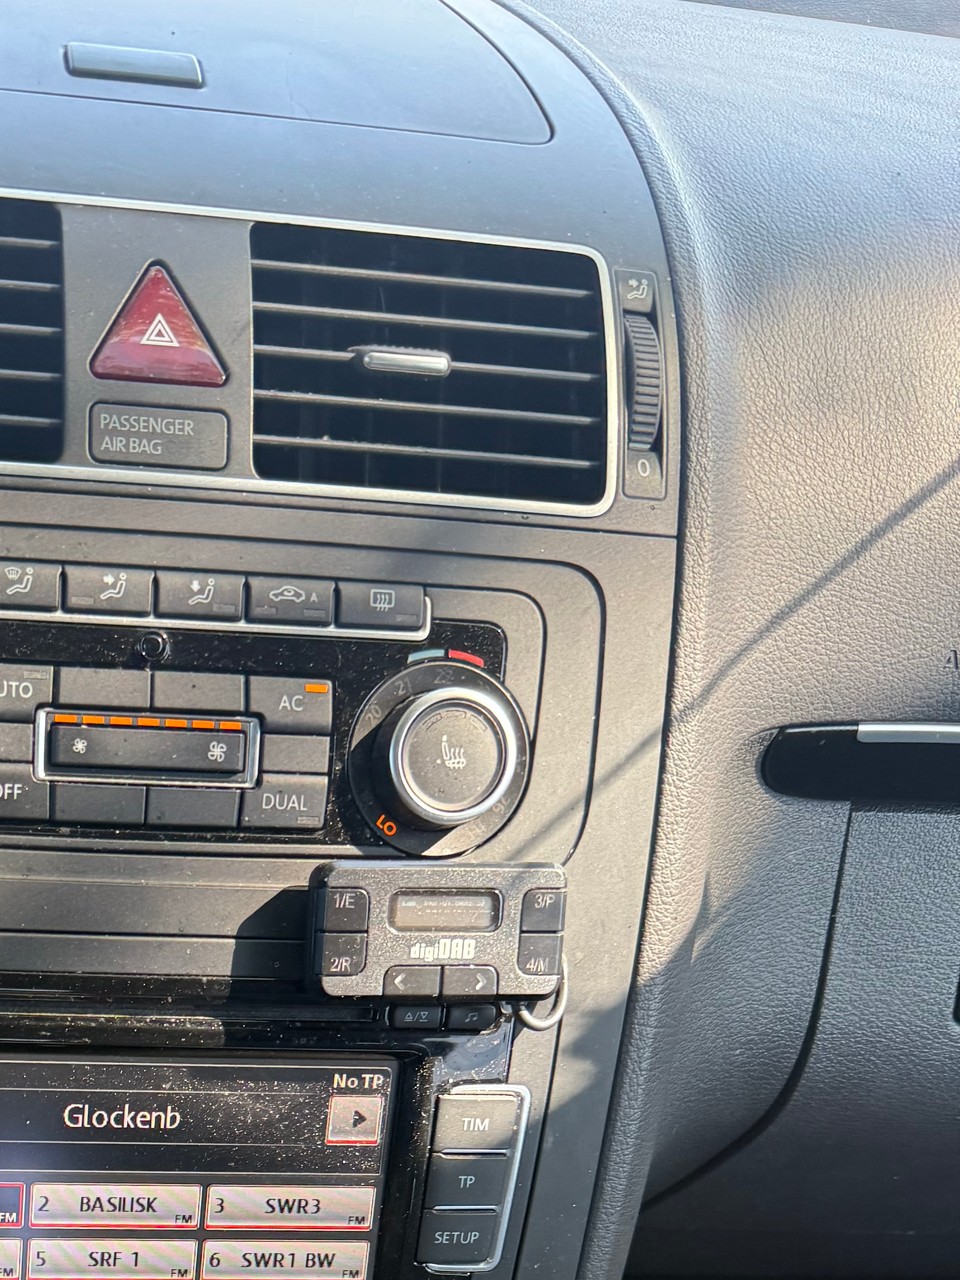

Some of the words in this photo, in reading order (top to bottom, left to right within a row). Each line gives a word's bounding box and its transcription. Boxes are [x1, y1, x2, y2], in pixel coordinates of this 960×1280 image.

[100, 413, 194, 436] PASSENGER
[100, 436, 126, 453] AIR
[129, 438, 162, 455] BAG
[637, 459, 650, 477] 0
[310, 593, 318, 603] A
[279, 695, 304, 712] AC
[261, 792, 308, 812] DUAL
[375, 814, 397, 836] LO
[334, 893, 355, 909] 1/E
[534, 894, 555, 909] 3/P
[410, 938, 476, 962] digiDAB
[330, 957, 350, 972] 2/R
[333, 1073, 358, 1088] No
[362, 1074, 383, 1088] TP
[63, 1103, 181, 1130] Glockenb
[461, 1117, 490, 1131] TIM
[458, 1175, 475, 1189] TP
[37, 1196, 50, 1212] 2
[79, 1196, 158, 1213] BASILISK
[175, 1215, 192, 1224] FM
[215, 1198, 224, 1213] 3
[265, 1198, 321, 1214] SWR3
[348, 1216, 365, 1225] FM
[434, 1232, 479, 1244] SETUP
[36, 1251, 46, 1267] 5
[88, 1251, 122, 1267] SRF
[131, 1252, 139, 1267] 1
[171, 1269, 188, 1278] FM
[210, 1252, 221, 1268] 6
[241, 1252, 295, 1268] SWR1
[305, 1253, 335, 1268] BW
[342, 1269, 359, 1279] FM
